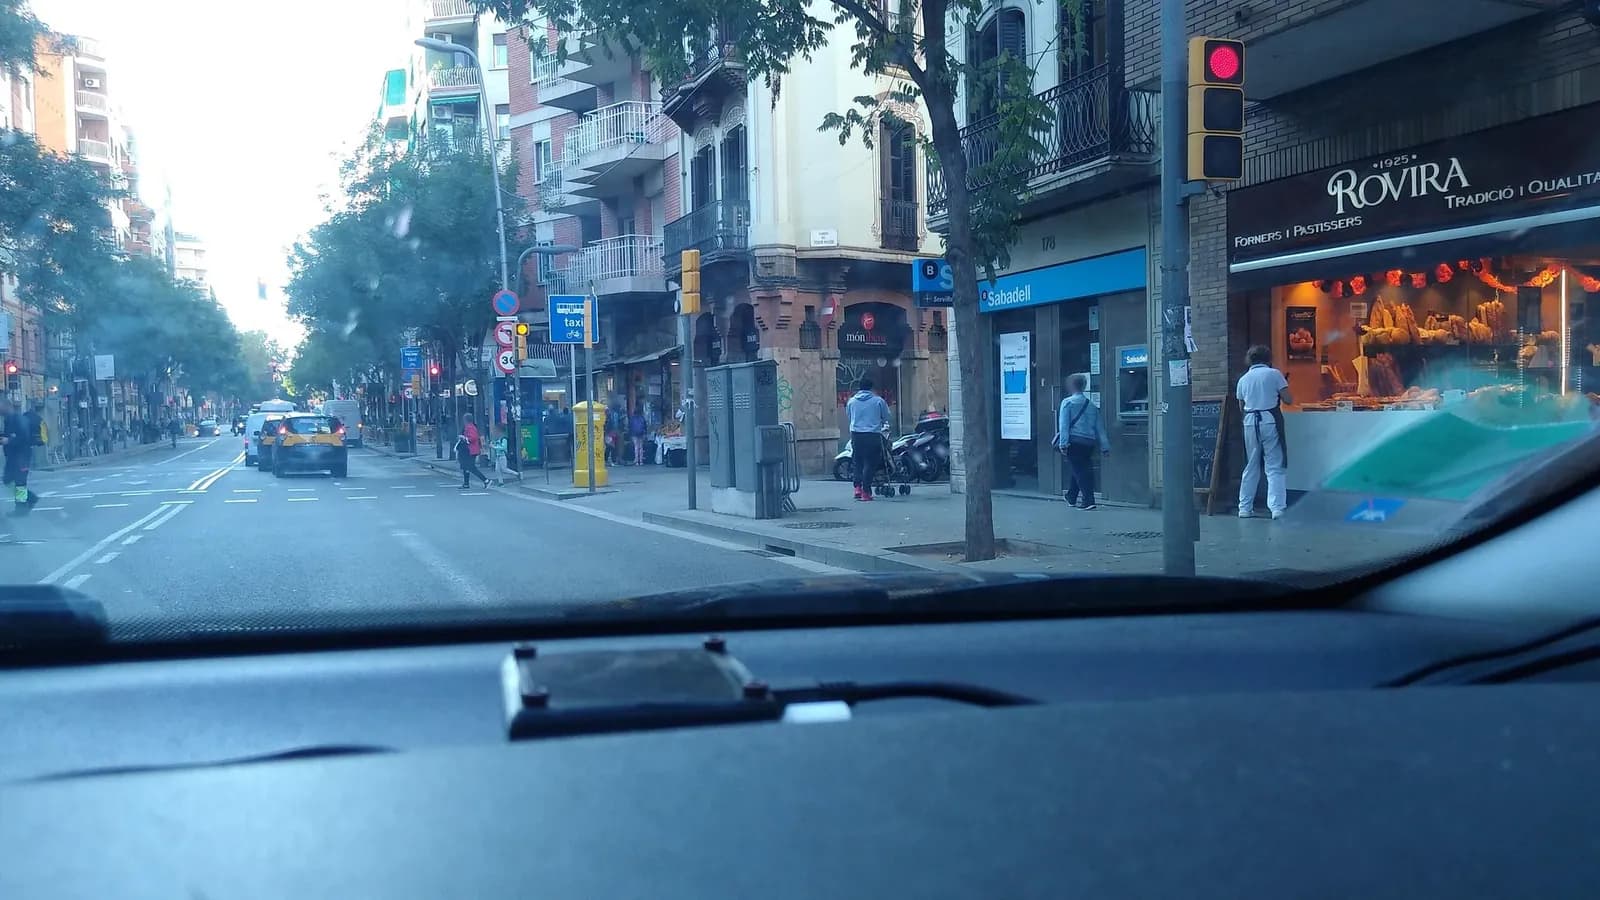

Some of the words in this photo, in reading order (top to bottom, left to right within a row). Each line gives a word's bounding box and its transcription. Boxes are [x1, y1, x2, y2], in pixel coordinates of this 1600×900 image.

[1327, 157, 1470, 214] ROVIRA
[1234, 230, 1282, 248] FORNERS
[1293, 215, 1362, 237] PASTISSERS
[1041, 236, 1056, 252] 178
[988, 284, 1031, 307] Sabadell
[564, 317, 585, 327] taxi
